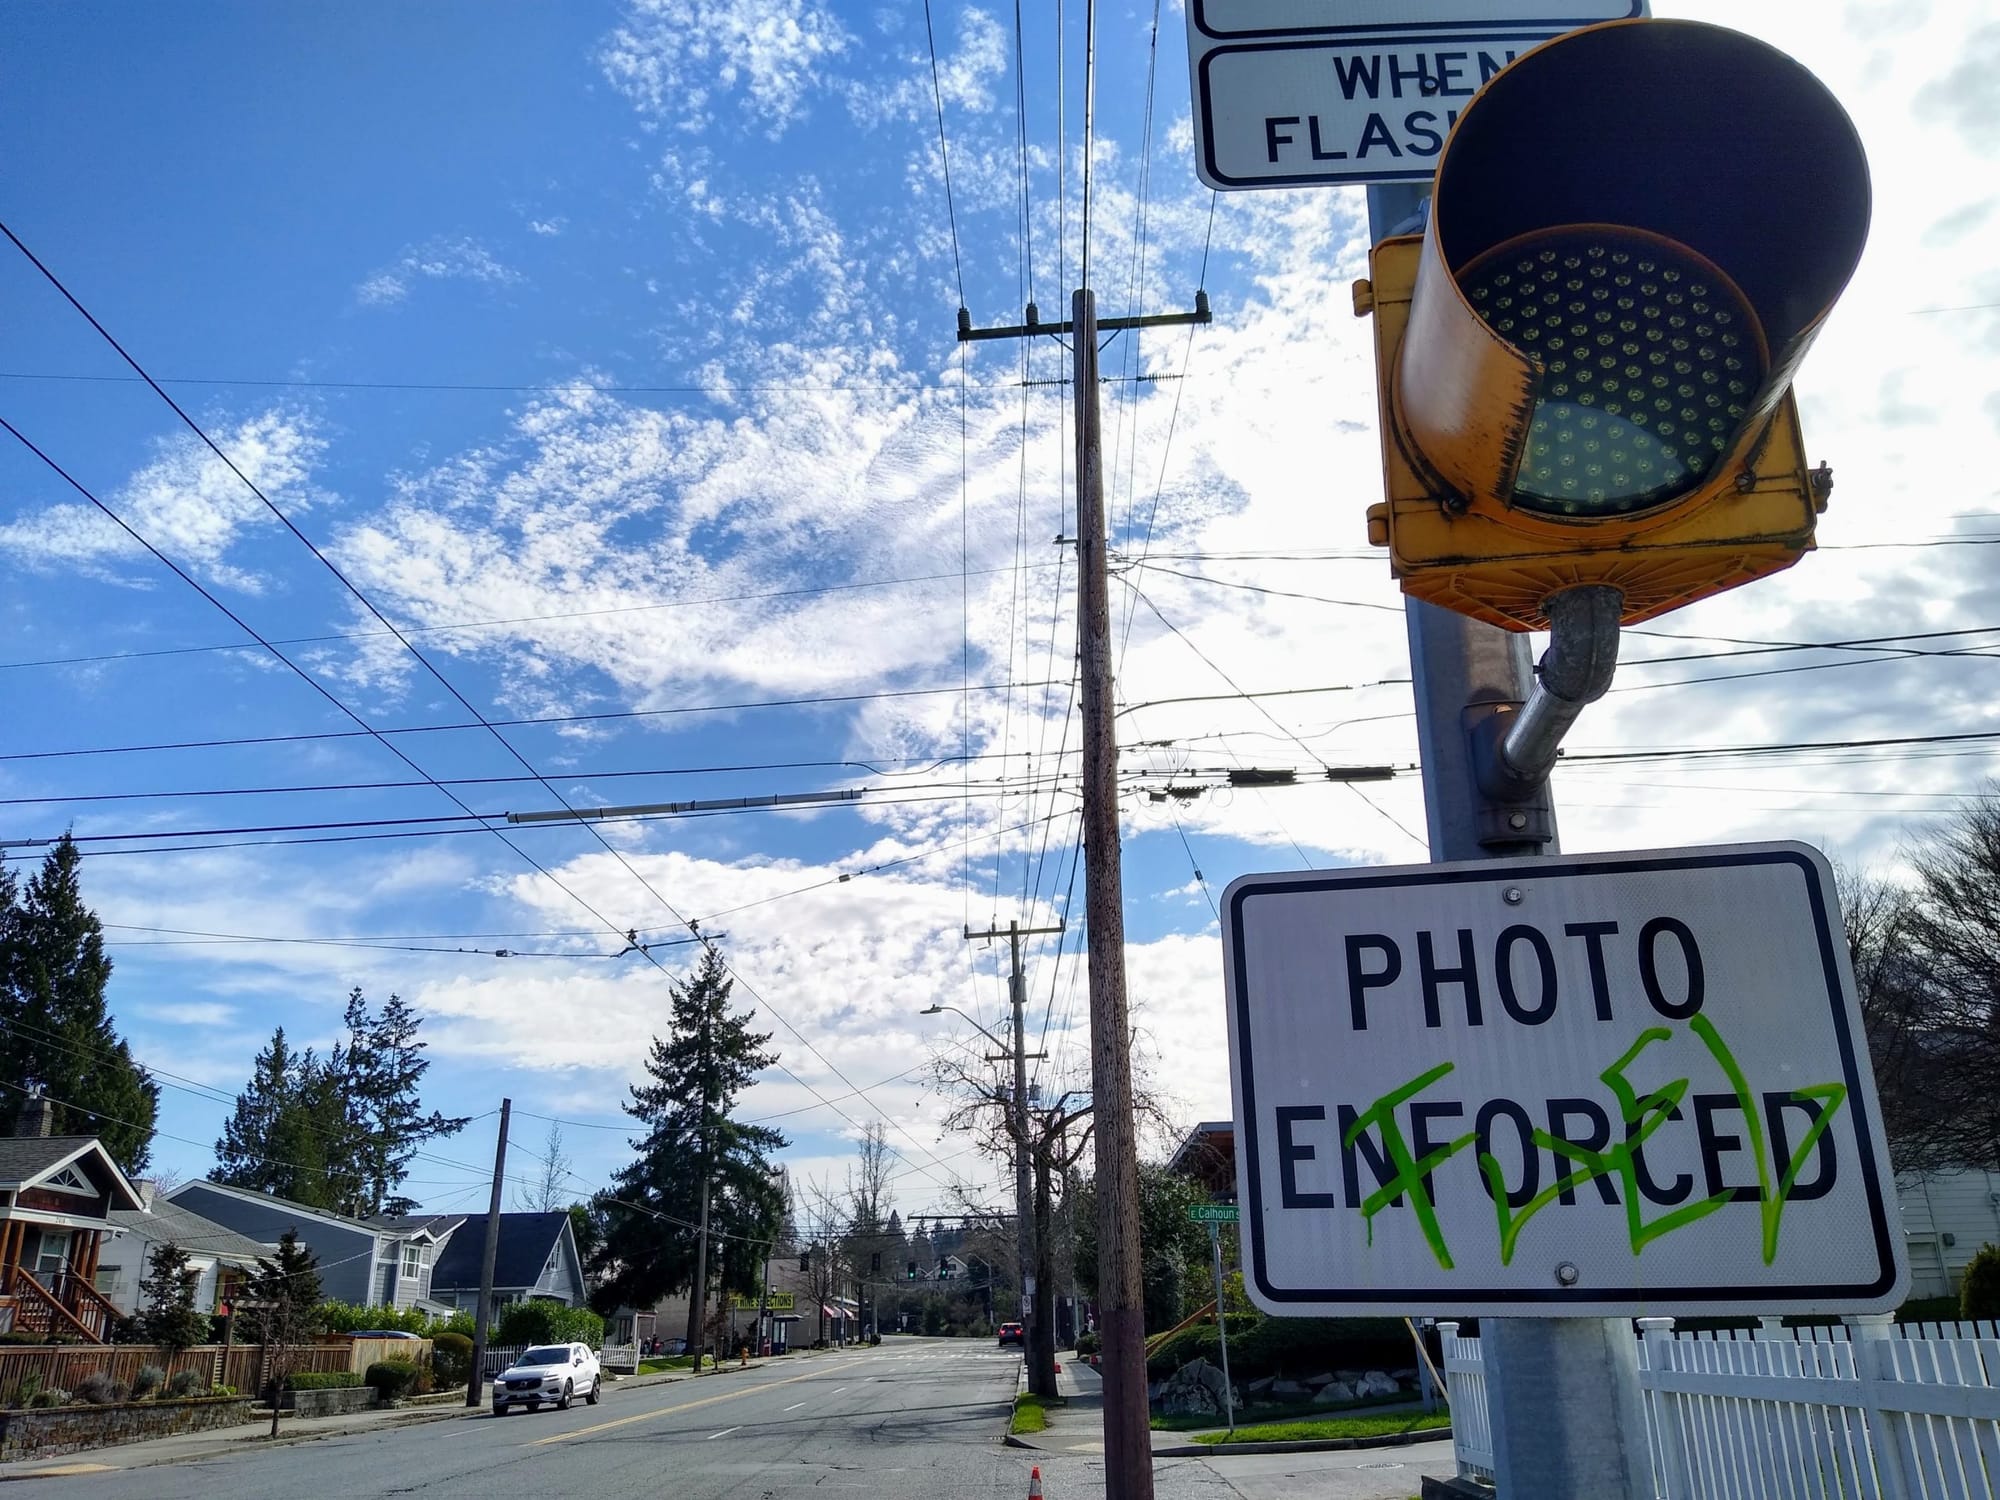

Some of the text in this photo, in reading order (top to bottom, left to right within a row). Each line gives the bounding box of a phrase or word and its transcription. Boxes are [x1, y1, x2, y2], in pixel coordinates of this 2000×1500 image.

[1332, 50, 1517, 101] WHEN
[1265, 109, 1458, 163] FLAS
[1344, 916, 1705, 1031] PHOTO
[1275, 1090, 1838, 1210] ENFORCED
[1191, 1210, 1196, 1218] E
[1198, 1207, 1235, 1219] Calhoun
